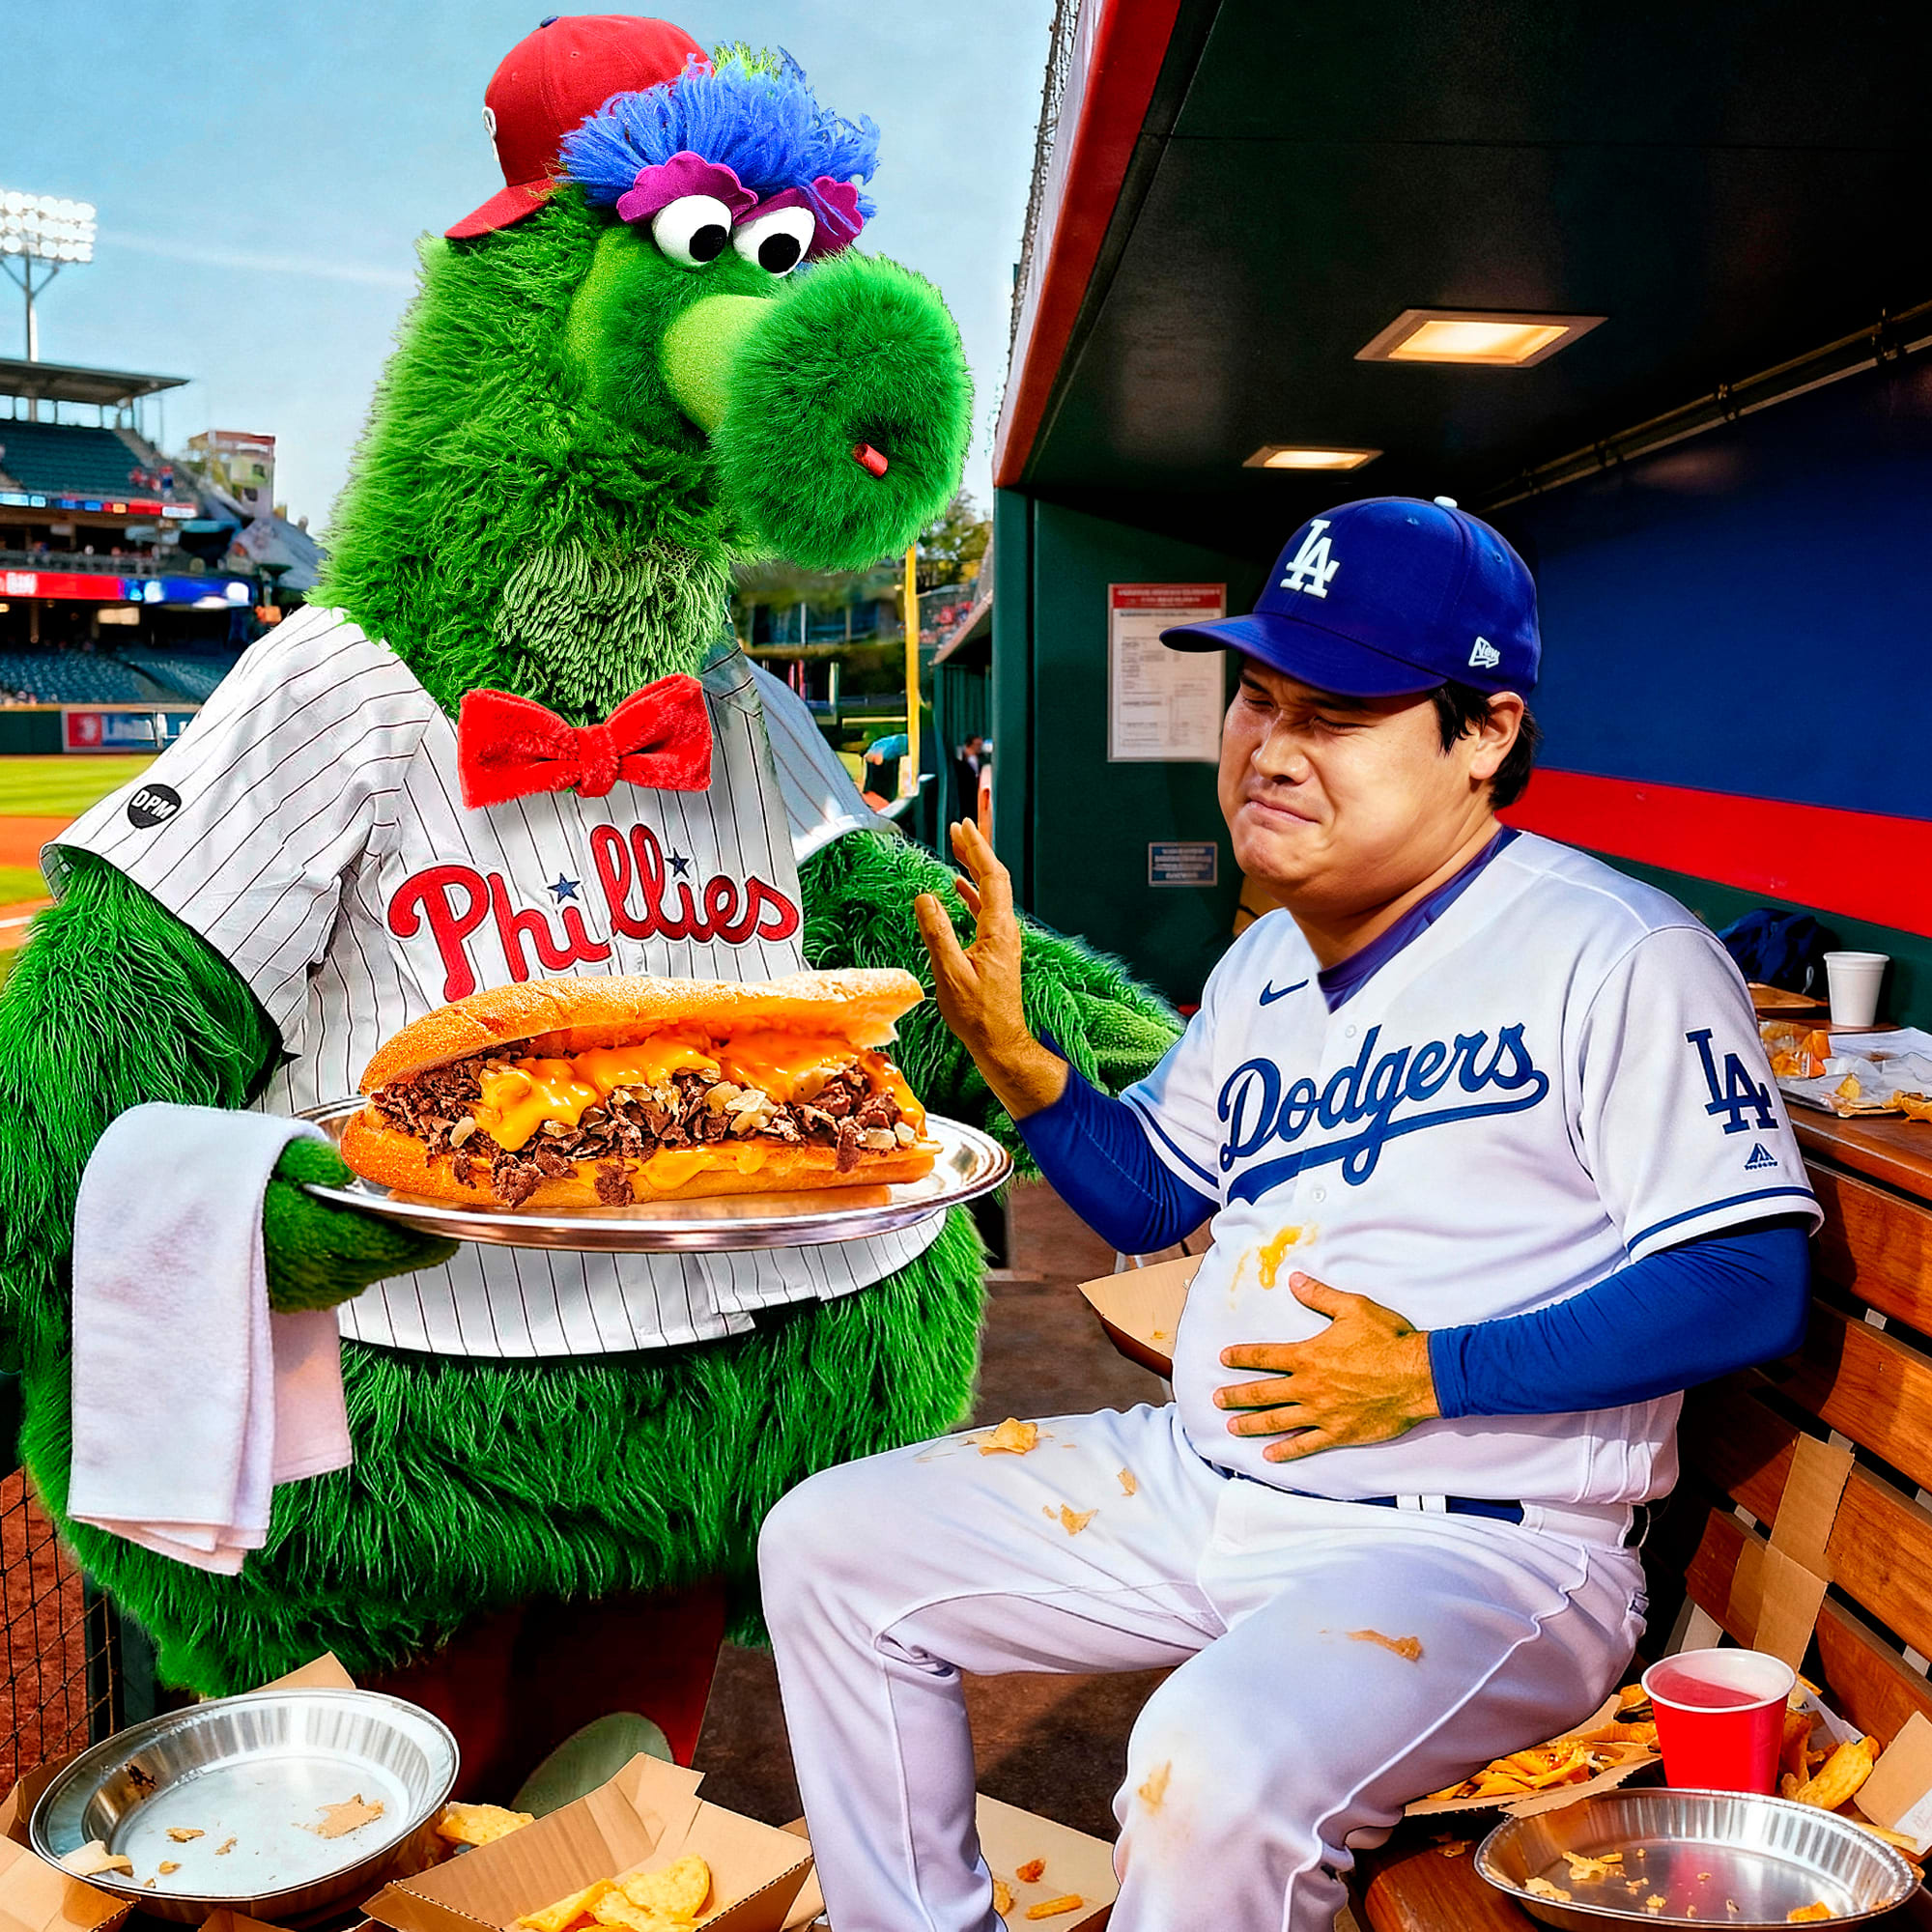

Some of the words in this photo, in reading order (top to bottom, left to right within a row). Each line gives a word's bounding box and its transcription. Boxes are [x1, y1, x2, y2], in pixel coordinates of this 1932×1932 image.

[1280, 519, 1340, 598] LA
[131, 789, 178, 819] DPM
[388, 823, 800, 1003] Phillies
[1218, 1023, 1548, 1189] Dodgers
[1686, 1029, 1778, 1134] LA
